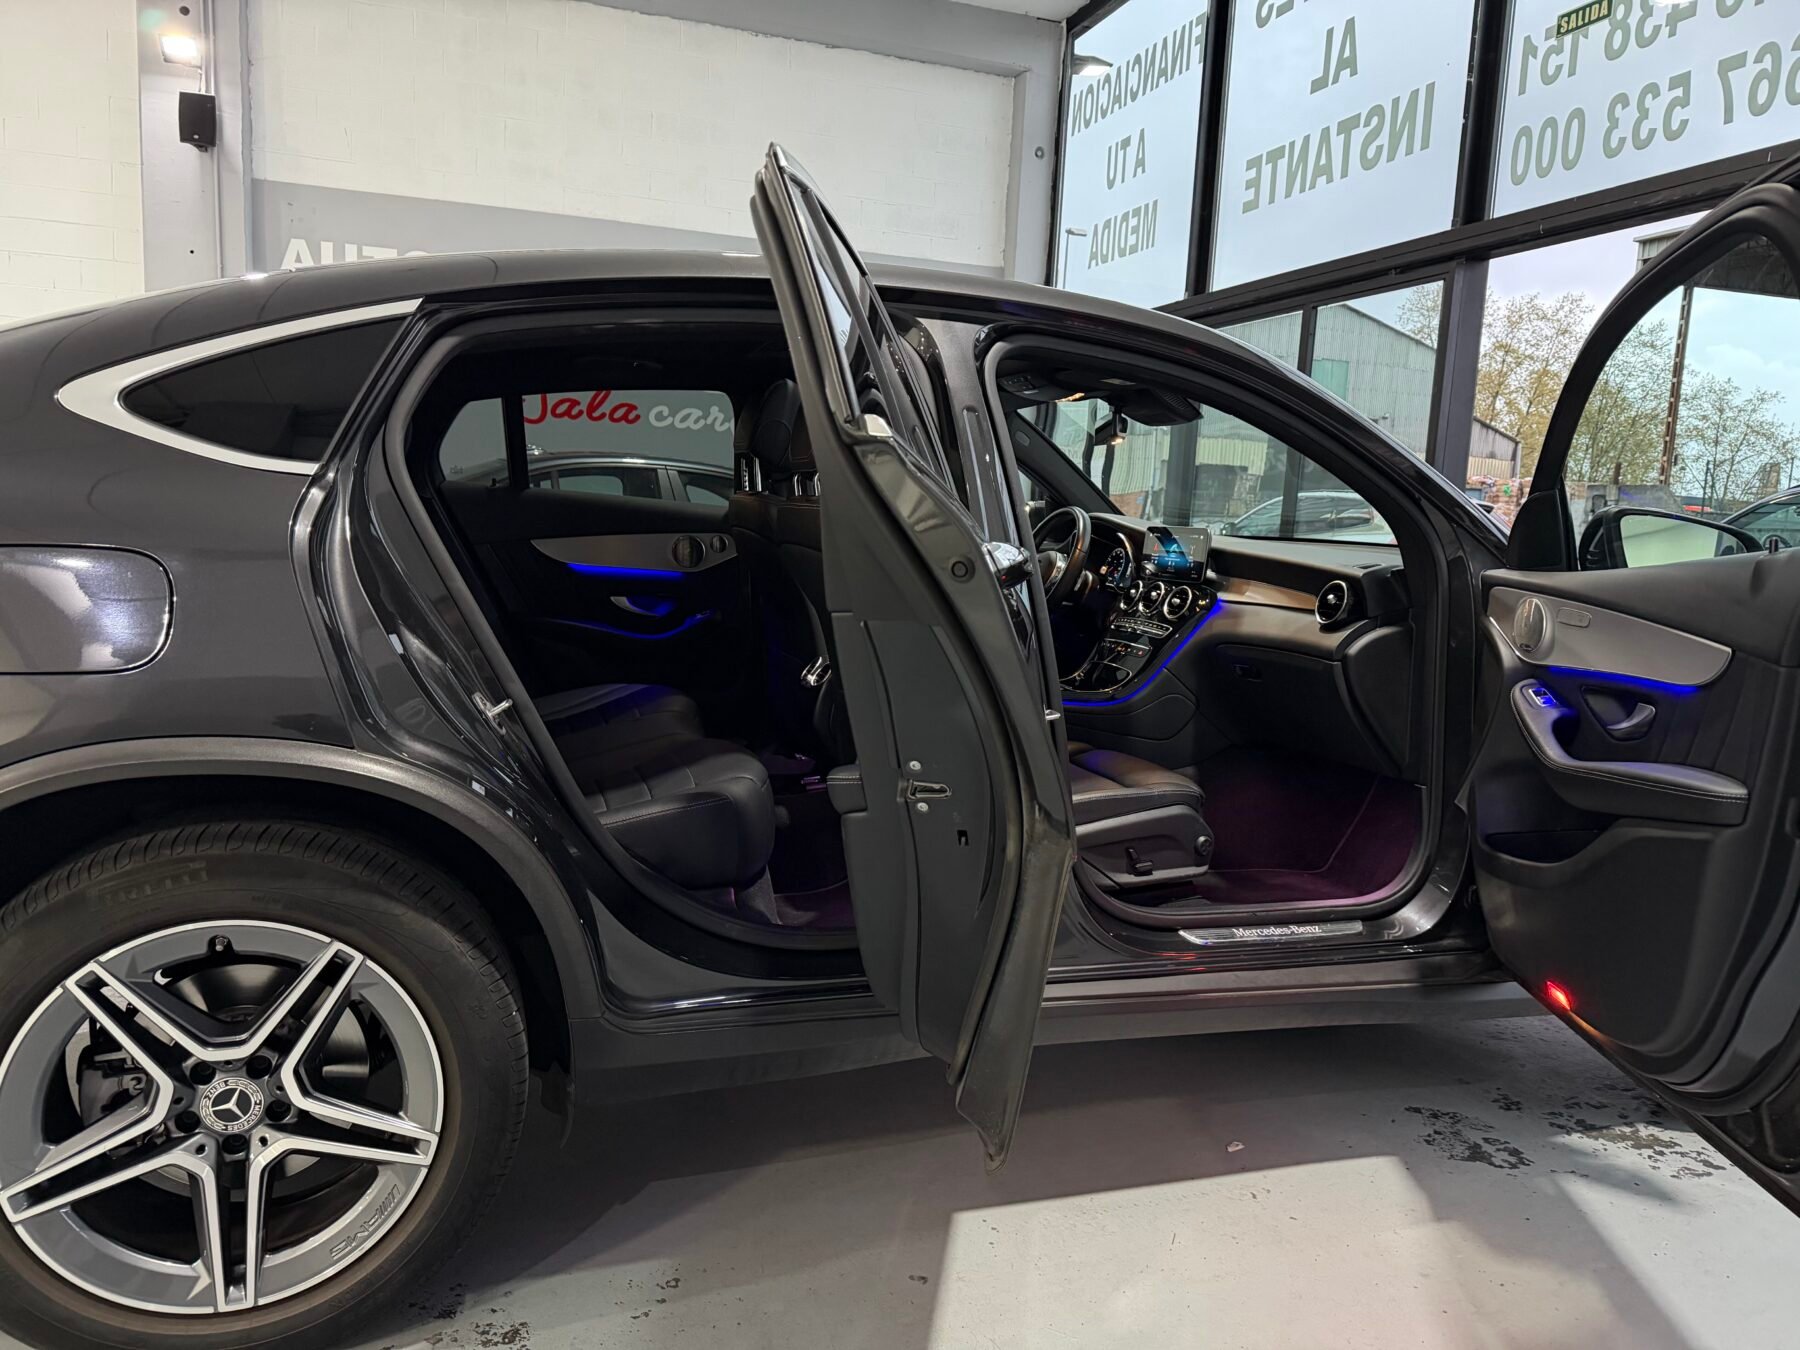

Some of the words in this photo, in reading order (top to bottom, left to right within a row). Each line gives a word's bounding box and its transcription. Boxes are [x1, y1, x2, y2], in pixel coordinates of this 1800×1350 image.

[1560, 0, 1609, 33] SALIDA
[280, 238, 430, 270] AU
[648, 404, 735, 432] car
[1232, 924, 1322, 937] Mercedes-Benz
[207, 1081, 226, 1098] BENZ
[227, 1104, 262, 1131] MERCEDES
